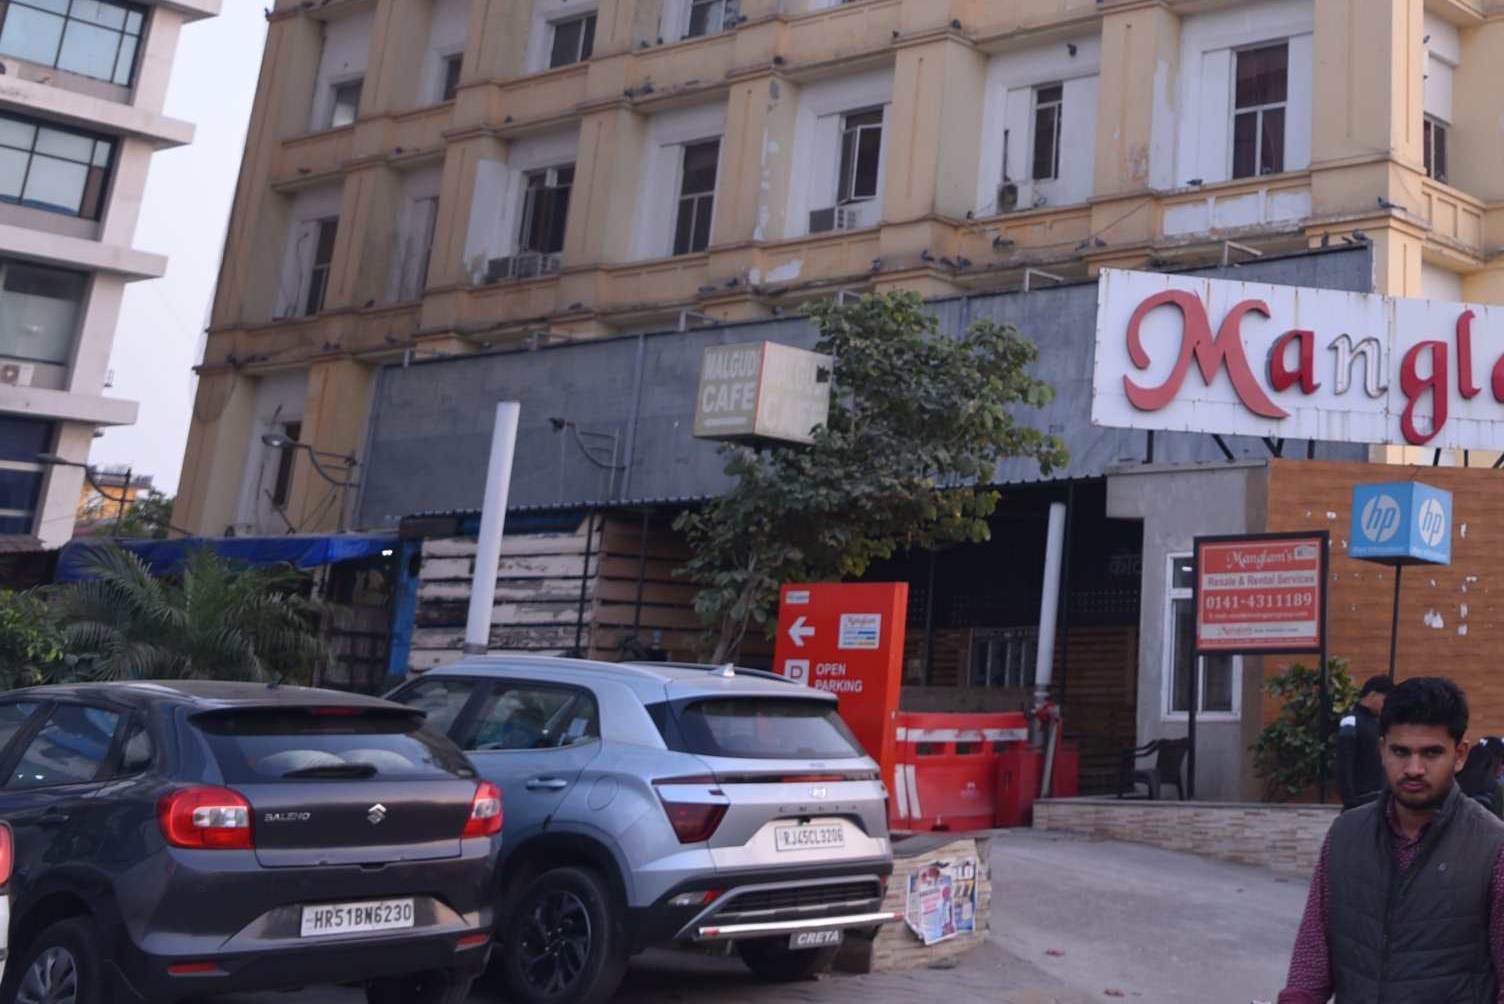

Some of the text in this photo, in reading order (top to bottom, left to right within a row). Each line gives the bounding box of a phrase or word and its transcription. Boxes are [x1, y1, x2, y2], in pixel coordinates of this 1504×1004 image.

[702, 381, 756, 413] CAFE
[1364, 495, 1399, 543] hp
[1420, 498, 1444, 547] hp
[1208, 573, 1315, 587] Resale & Rental Services
[1206, 593, 1312, 609] 0141-4311189
[815, 663, 846, 676] OPEN
[815, 679, 863, 693] PARKING
[264, 812, 311, 822] BALENO
[313, 903, 412, 929] HR51BN6230
[796, 930, 840, 945] CRETA
